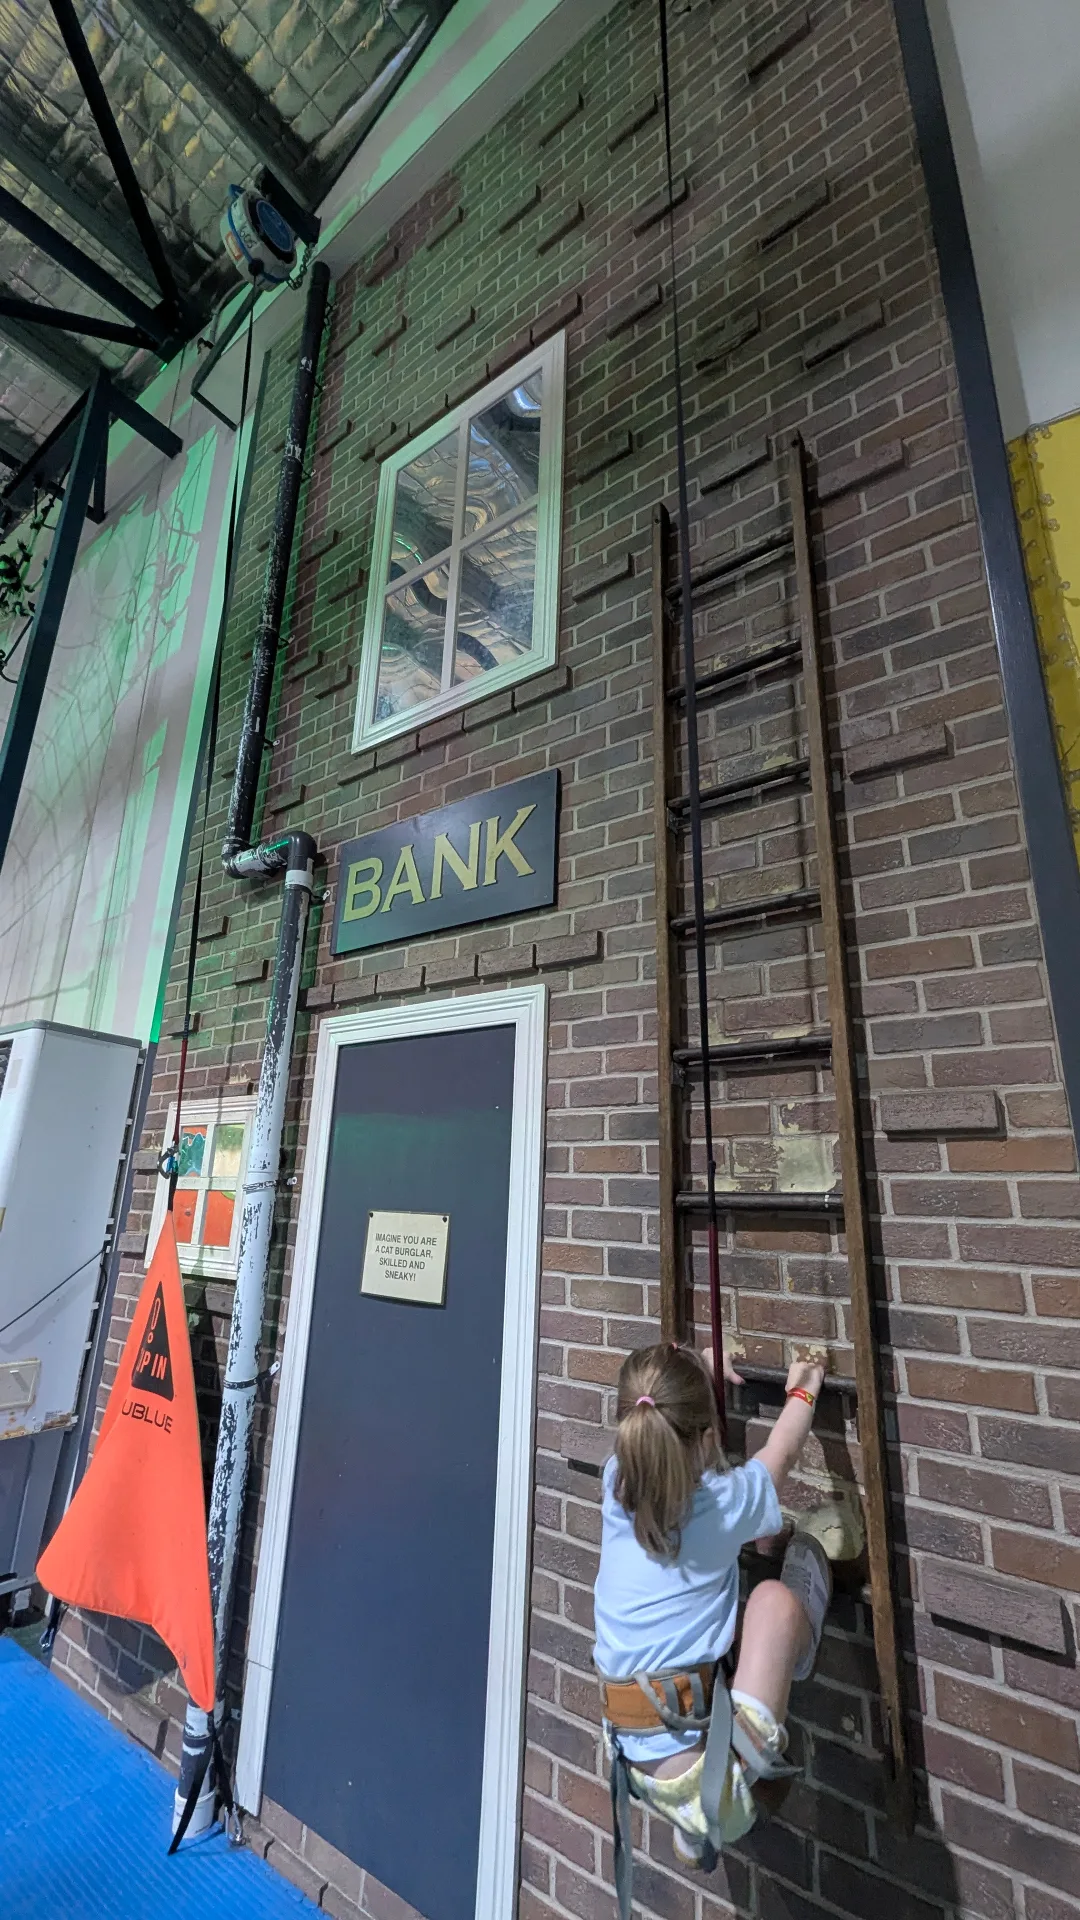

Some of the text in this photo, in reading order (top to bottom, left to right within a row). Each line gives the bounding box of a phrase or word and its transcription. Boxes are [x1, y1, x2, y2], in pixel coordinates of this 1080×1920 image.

[342, 803, 538, 923] BANK
[375, 1233, 437, 1246] IMAGINE YOU ARE
[375, 1245, 433, 1259] A CAT BURGLAR,
[379, 1257, 426, 1270] SKILLED AND
[385, 1270, 416, 1281] SNEAKY!
[136, 1347, 168, 1380] IP IN
